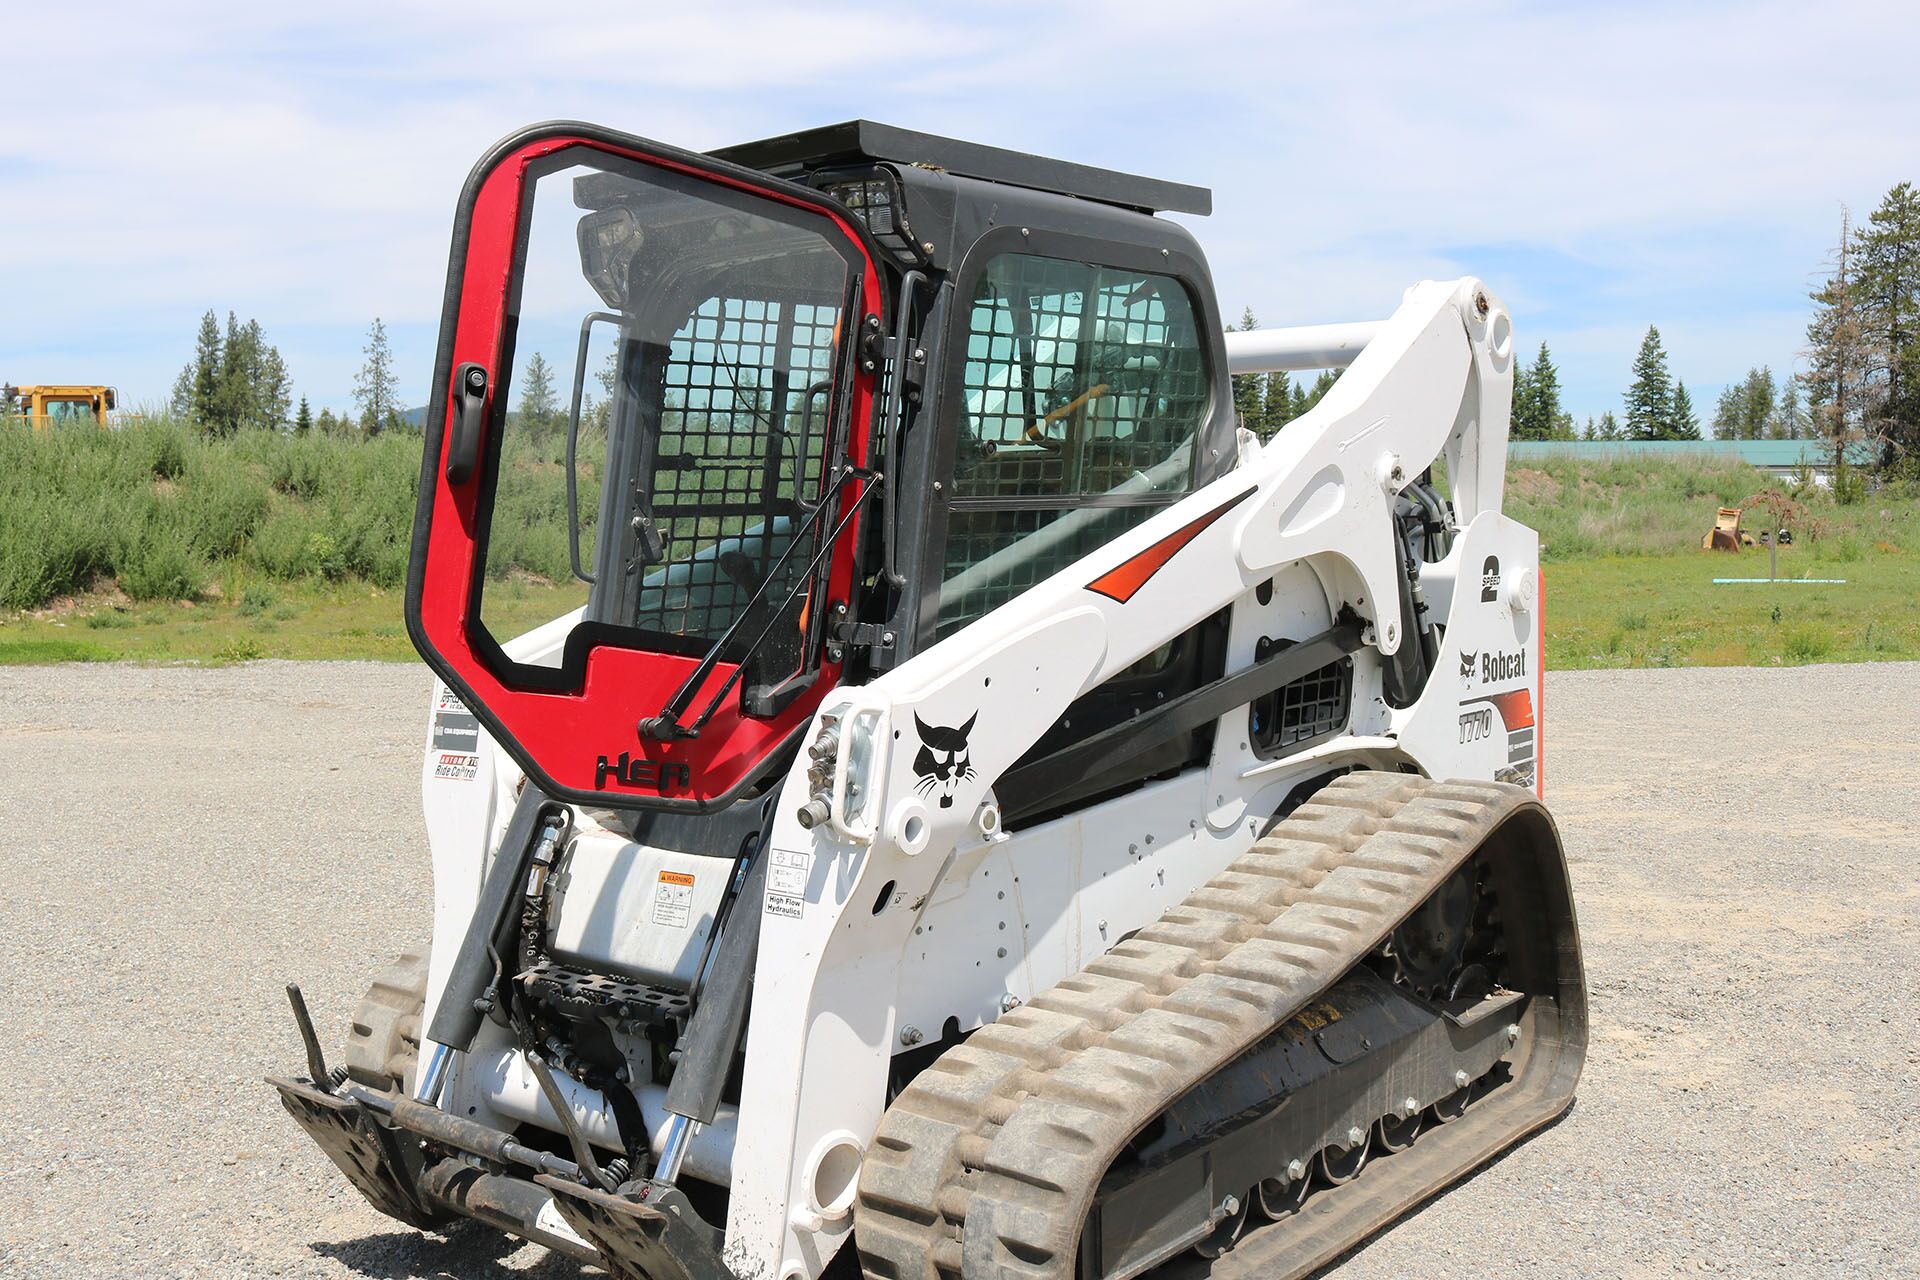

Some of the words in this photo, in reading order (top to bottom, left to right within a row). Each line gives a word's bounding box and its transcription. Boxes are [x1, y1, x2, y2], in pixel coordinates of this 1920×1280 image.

[1481, 555, 1499, 602] 2
[1482, 576, 1500, 587] SPEED
[1482, 648, 1525, 683] Bobcat
[1459, 708, 1492, 744] T770
[435, 765, 451, 776] Ride
[666, 875, 692, 884] WARNING
[769, 895, 784, 905] High
[785, 898, 801, 907] Flow
[767, 904, 801, 915] Hydraulics
